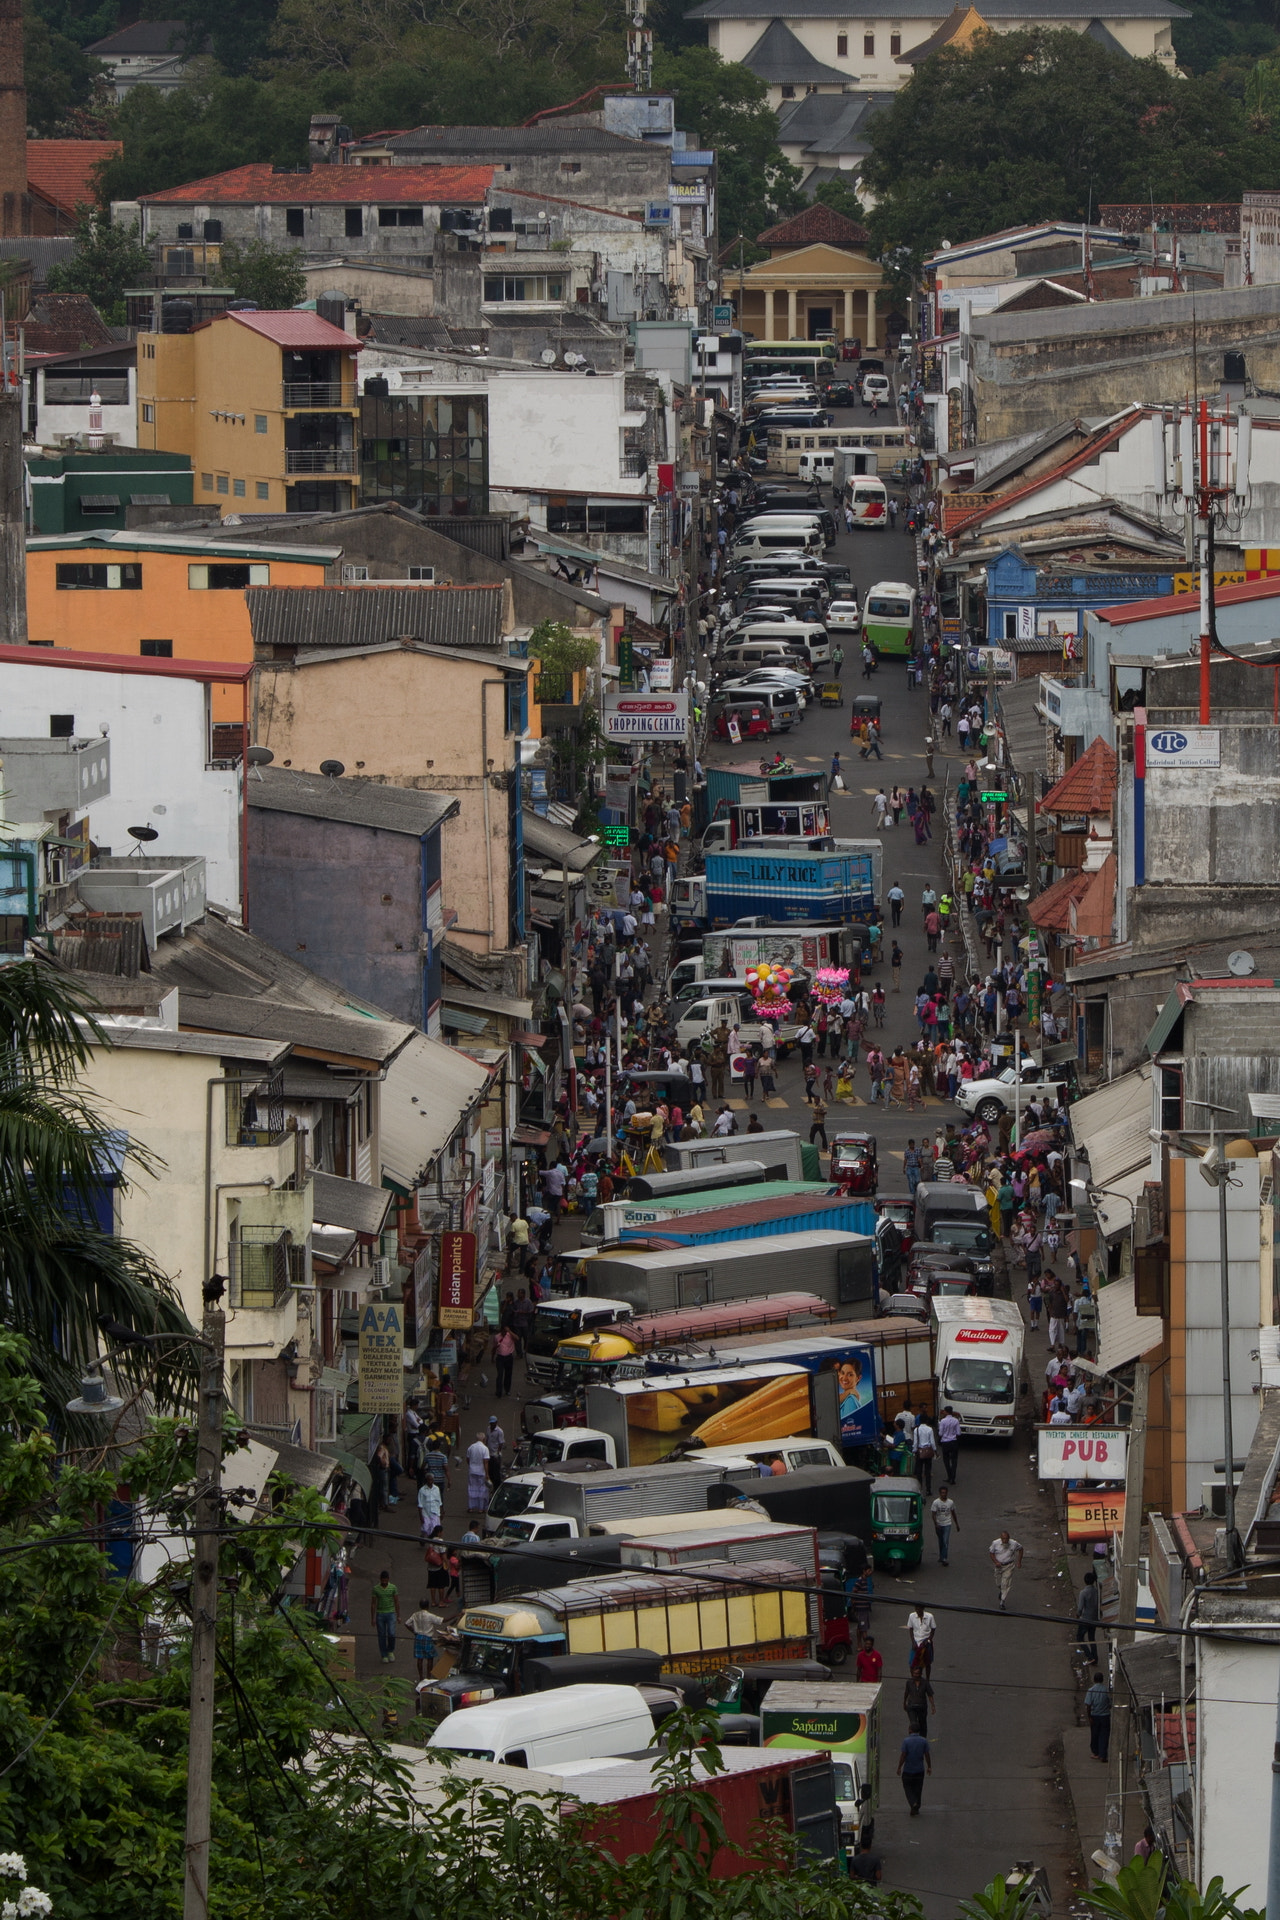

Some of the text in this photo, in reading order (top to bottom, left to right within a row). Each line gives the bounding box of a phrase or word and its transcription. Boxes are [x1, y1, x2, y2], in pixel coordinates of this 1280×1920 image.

[669, 185, 705, 196] MIRACLE
[608, 717, 686, 731] SHOPPING CENTRE
[751, 864, 817, 883] LILY RICE
[366, 1335, 396, 1347] TEX
[960, 1330, 1002, 1340] Maliban
[1070, 1431, 1089, 1439] CHINESE
[1092, 1431, 1119, 1439] RESTAURANT
[1062, 1440, 1109, 1463] PUB
[1085, 1509, 1119, 1521] BEER
[661, 1655, 740, 1674] RANSPORT
[791, 1718, 838, 1734] Sapumal
